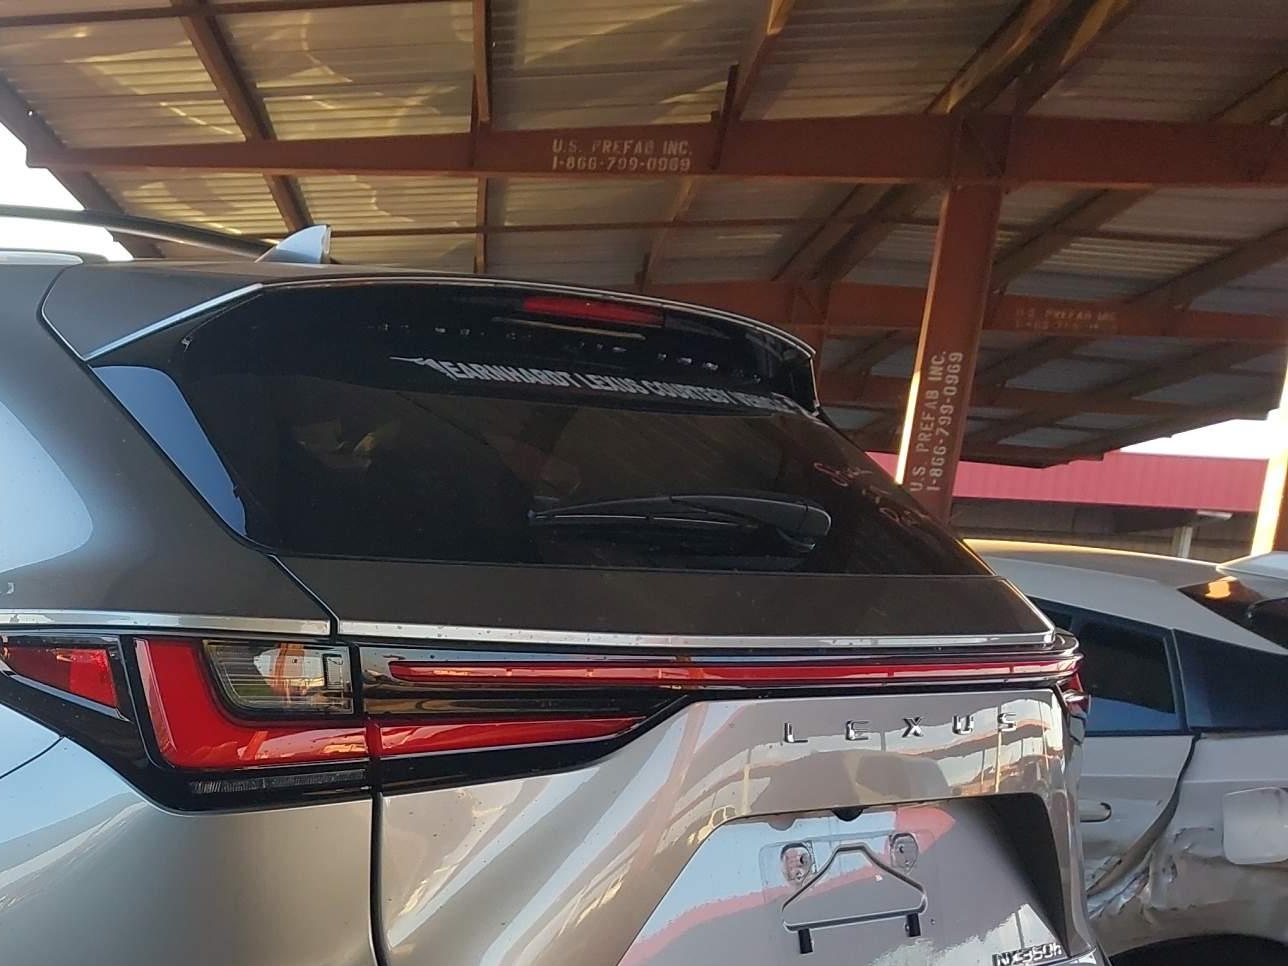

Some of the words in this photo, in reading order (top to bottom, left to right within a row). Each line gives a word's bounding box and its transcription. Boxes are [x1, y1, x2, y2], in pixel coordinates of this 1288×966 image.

[439, 359, 582, 389] EARNHARDT
[573, 372, 650, 395] LEXUS
[927, 351, 947, 382] INC.
[915, 389, 940, 453] PREFAB
[925, 351, 964, 492] 1-866-799-0969
[909, 461, 928, 492] U.S.
[783, 711, 1017, 744] LEXUS
